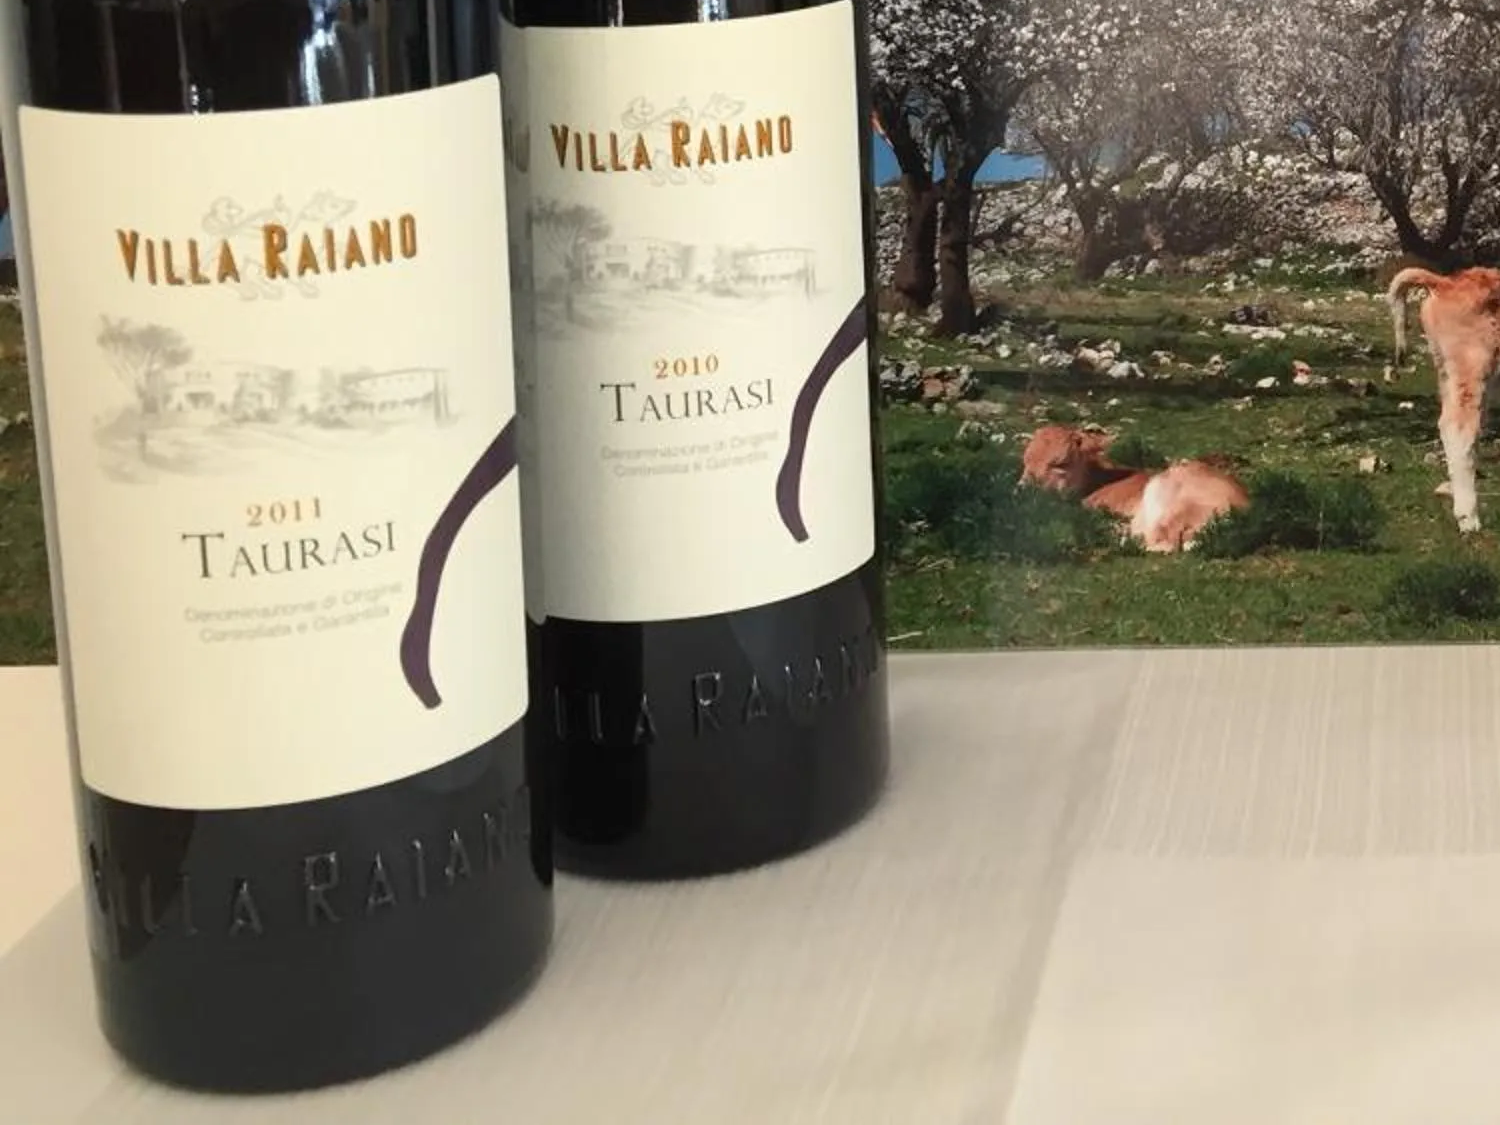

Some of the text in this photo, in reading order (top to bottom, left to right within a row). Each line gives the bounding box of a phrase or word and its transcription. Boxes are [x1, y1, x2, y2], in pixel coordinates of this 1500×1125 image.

[549, 123, 653, 173] VILLA
[670, 113, 794, 169] RAIANO
[116, 213, 419, 286] VILLA RAIANO
[655, 354, 720, 380] 2010
[600, 377, 774, 422] TAURASI
[246, 495, 322, 528] 2011
[181, 521, 396, 579] TAURASI
